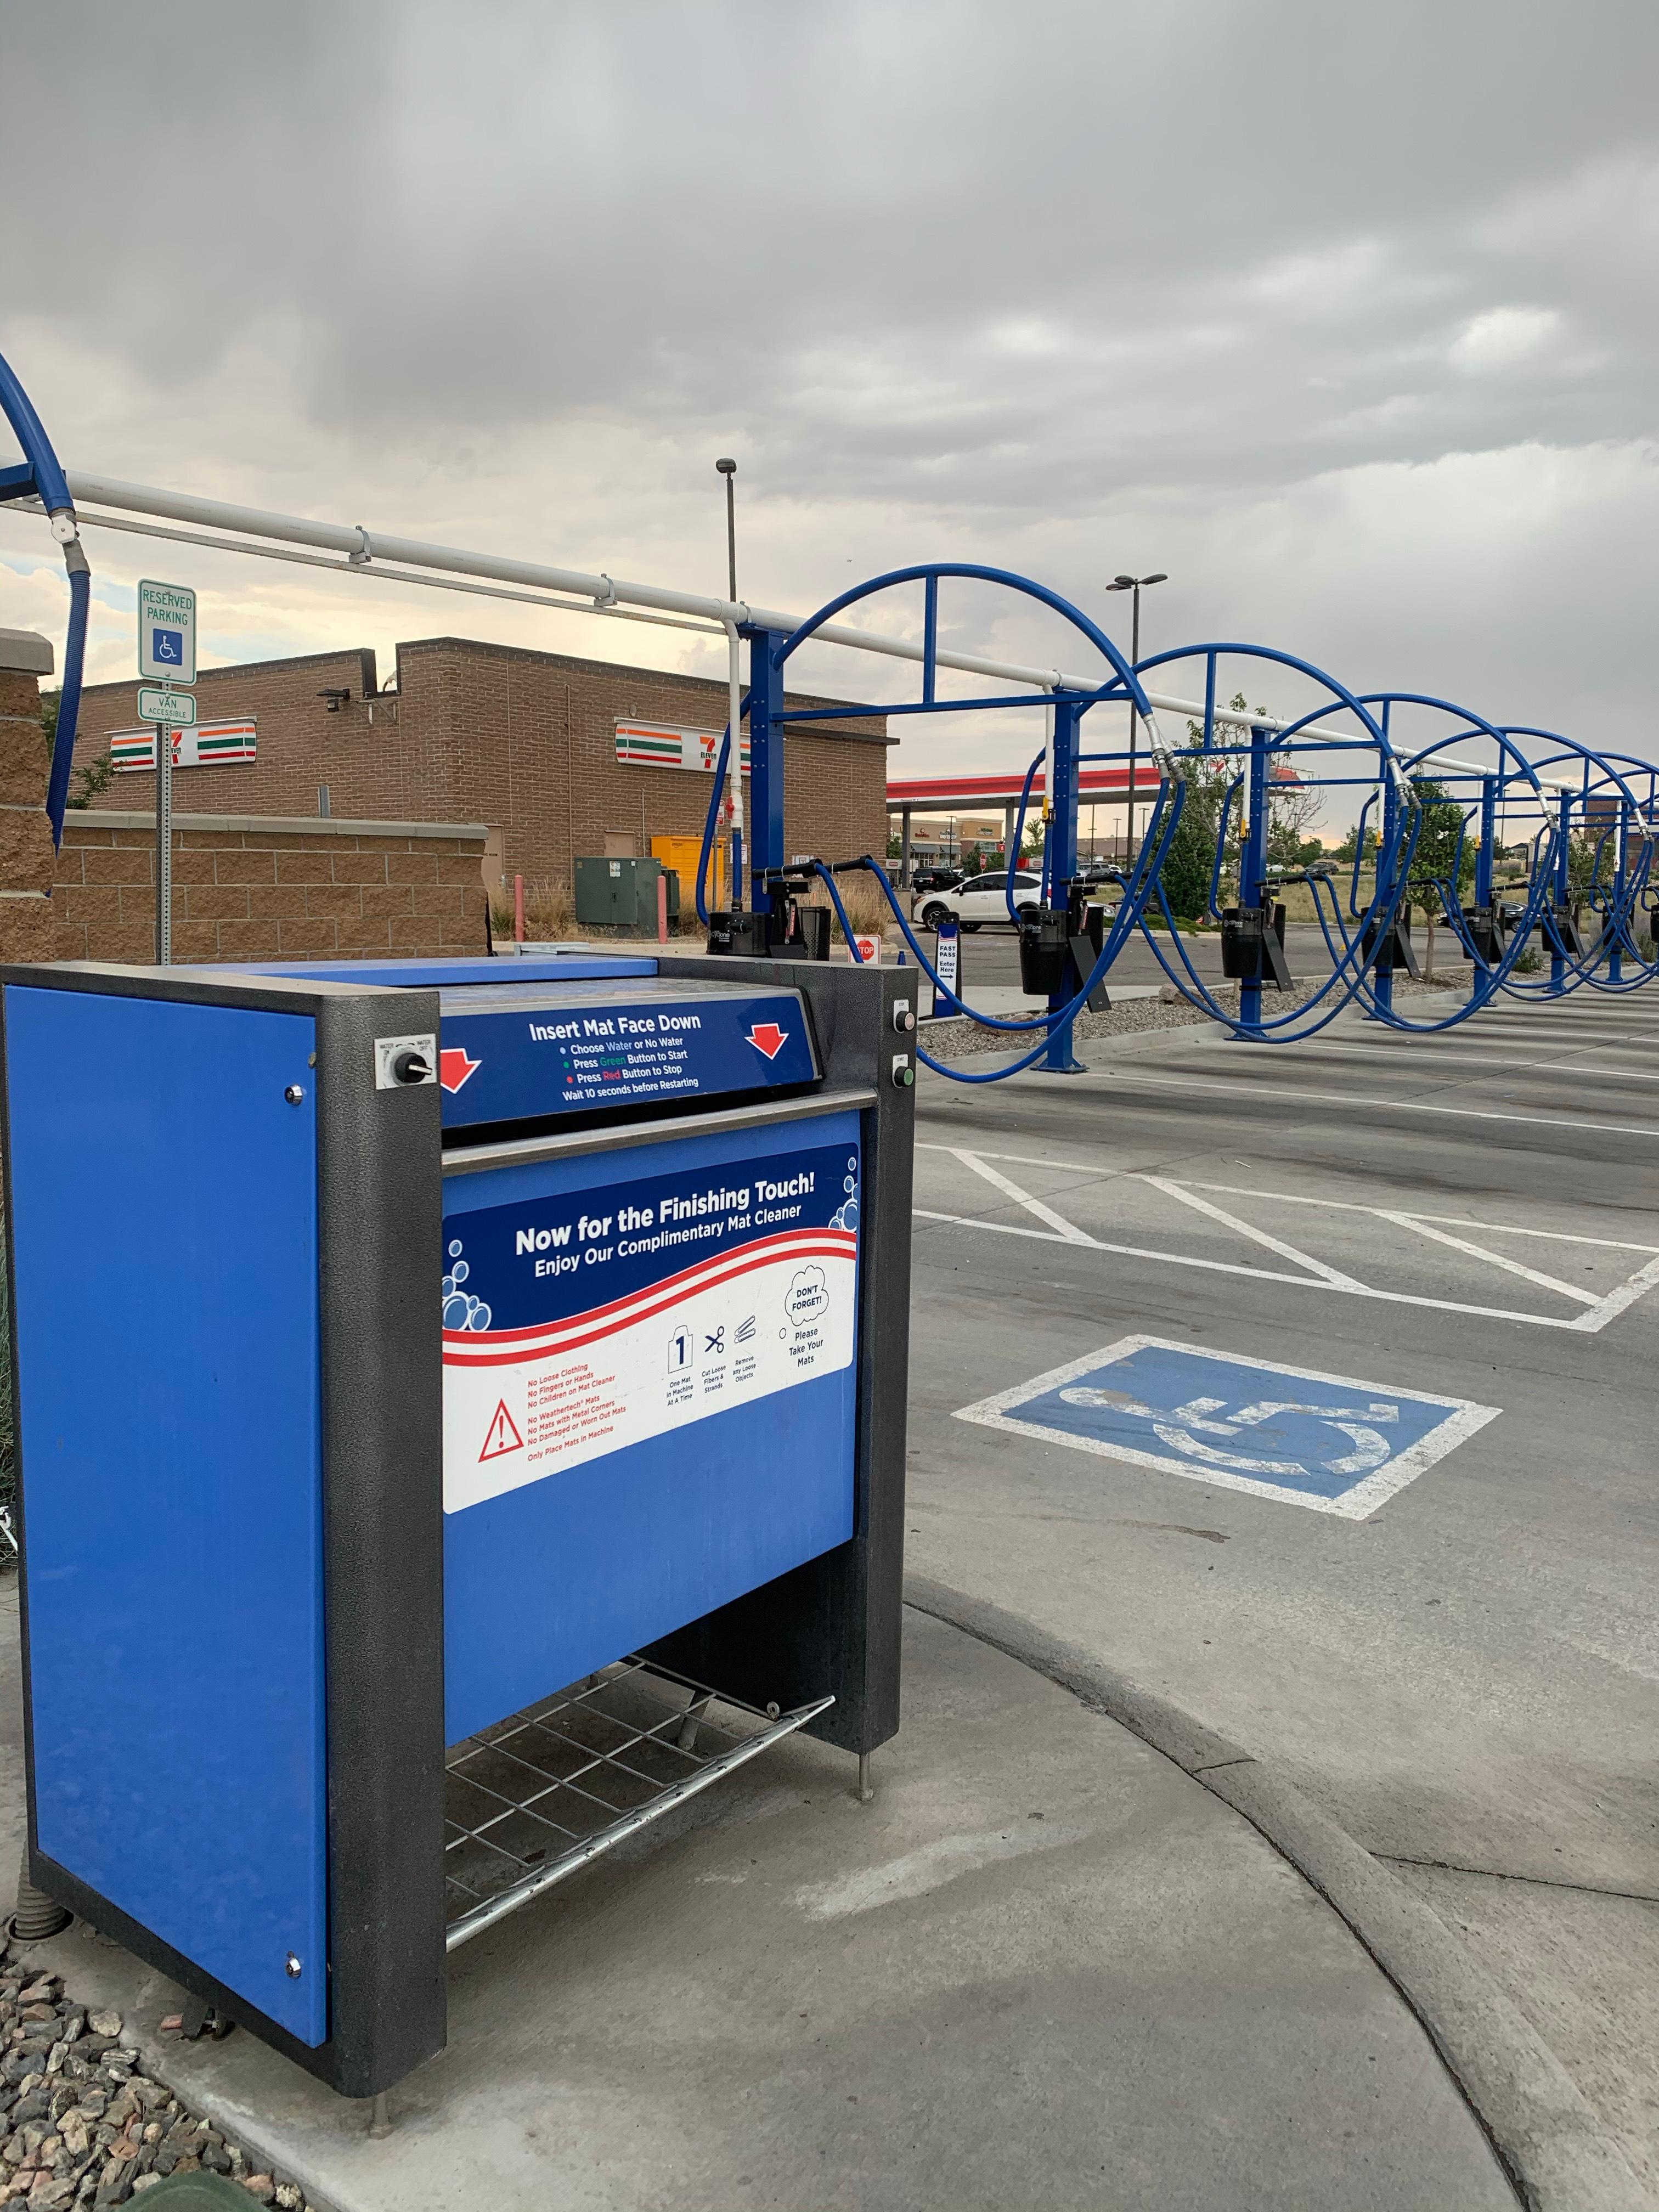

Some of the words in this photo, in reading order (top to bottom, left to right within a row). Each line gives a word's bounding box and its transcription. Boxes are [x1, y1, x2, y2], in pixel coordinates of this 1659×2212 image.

[143, 589, 192, 610] RESERVED
[148, 607, 188, 625] PARKING
[159, 697, 177, 709] VAN
[149, 708, 187, 718] ACCESSIBLE
[529, 1021, 581, 1041] Insert
[583, 1018, 616, 1037] Mat
[618, 1017, 655, 1034] Face
[658, 1014, 701, 1031] Down
[570, 1043, 605, 1055] Choose
[606, 1041, 633, 1052] Water
[634, 1041, 644, 1049] or
[645, 1039, 658, 1048] No
[658, 1036, 683, 1047] Water
[573, 1059, 599, 1069] Press
[600, 1056, 626, 1066] Green
[627, 1053, 656, 1064] Button
[657, 1052, 667, 1061] to
[668, 1049, 688, 1059] Start
[577, 1073, 602, 1084] Press
[602, 1070, 621, 1080] Red
[622, 1068, 651, 1079] Button
[652, 1066, 662, 1075] to
[663, 1065, 682, 1076] Stop
[562, 1090, 584, 1102] Wait
[584, 1087, 596, 1098] 10
[597, 1084, 631, 1097] seconds
[633, 1081, 659, 1093] before
[659, 1077, 699, 1091] Restarting
[515, 1224, 572, 1256] Now
[577, 1215, 612, 1241] for
[618, 1206, 653, 1233] the
[659, 1187, 749, 1224] Finishing
[754, 1172, 815, 1201] Touch!
[534, 1254, 580, 1278] Enjoy
[584, 1246, 614, 1265] Our
[617, 1221, 724, 1255] Complimentary
[727, 1216, 751, 1232] Mat
[754, 1205, 802, 1226] Cleaner
[797, 1285, 818, 1298] DON'T
[792, 1295, 822, 1312] FORGET!
[795, 1328, 818, 1341] Please
[676, 1335, 684, 1365] 1
[789, 1345, 805, 1356] Take
[808, 1339, 823, 1351] Your
[712, 1364, 726, 1374] Loose
[735, 1356, 754, 1366] Remove
[742, 1363, 756, 1372] Loose
[798, 1355, 814, 1367] Mats
[528, 1380, 538, 1388] No
[539, 1373, 559, 1384] Loose
[561, 1363, 588, 1377] Clothing
[539, 1382, 563, 1395] Fingers
[574, 1372, 594, 1384] Hands
[704, 1376, 719, 1385] Fibers
[735, 1372, 753, 1383] Objects
[528, 1401, 538, 1409] No
[539, 1391, 567, 1405] Children
[578, 1384, 590, 1392] Mat
[591, 1375, 616, 1387] Cleaner
[673, 1384, 693, 1396] Machine
[704, 1383, 723, 1393] Strands
[680, 1393, 693, 1402] Time
[528, 1417, 538, 1425] No
[585, 1395, 600, 1405] Mats
[528, 1427, 538, 1436] No
[539, 1421, 554, 1431] Mats
[556, 1415, 571, 1425] with
[572, 1408, 589, 1420] Metal
[591, 1400, 615, 1413] Corners
[528, 1438, 538, 1446] No
[539, 1426, 570, 1442] Damaged
[580, 1416, 597, 1426] Worn
[599, 1412, 611, 1420] Out
[612, 1406, 626, 1415] Mats
[528, 1452, 543, 1462] Only
[545, 1444, 562, 1455] Place
[564, 1438, 579, 1448] Mats
[588, 1426, 613, 1440] Machine
